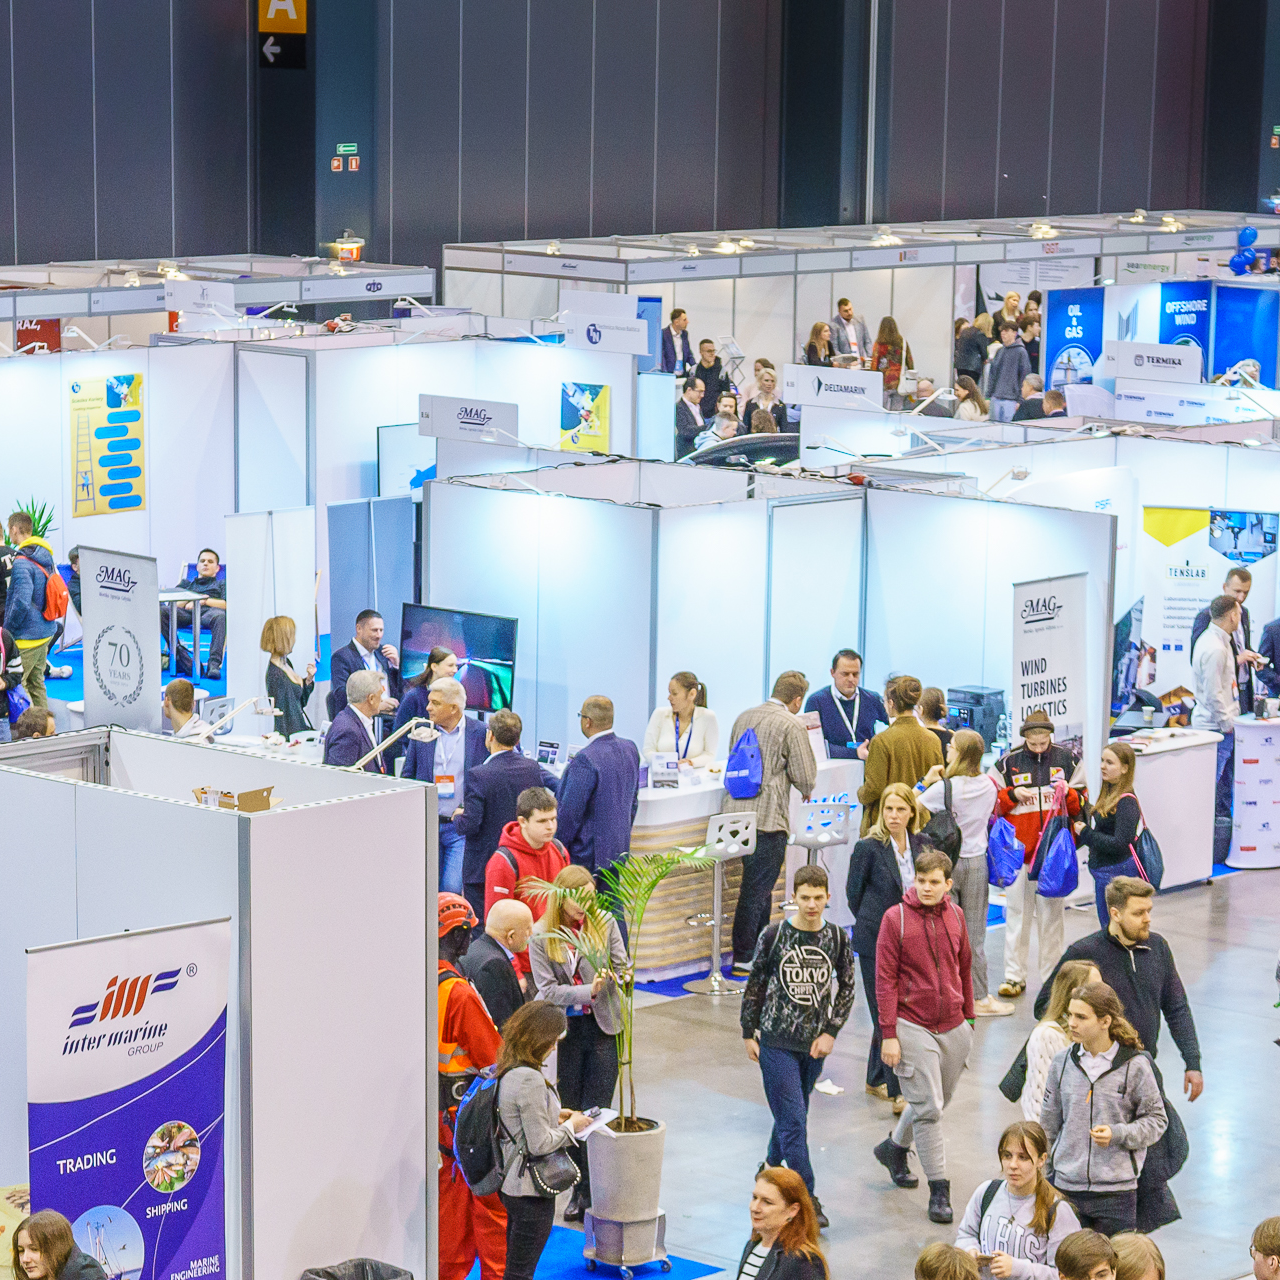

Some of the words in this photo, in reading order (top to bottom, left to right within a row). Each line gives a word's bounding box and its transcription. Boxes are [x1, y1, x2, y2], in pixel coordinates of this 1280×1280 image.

[267, 0, 297, 19] A
[1067, 305, 1082, 316] OIL
[1165, 300, 1208, 313] OFFSHORE
[1174, 313, 1197, 326] WIND
[1065, 326, 1083, 338] GAS
[1146, 356, 1182, 366] TERMIKA
[824, 383, 866, 395] DELTAMARIN
[96, 565, 134, 590] MAG
[1169, 568, 1206, 578] TENSLAB
[1021, 596, 1059, 619] MAG
[108, 641, 131, 668] 70
[109, 669, 131, 681] YEARS
[1021, 658, 1047, 677] WIND
[1021, 676, 1067, 700] TURBINES
[1021, 699, 1067, 722] LOGISTICS
[783, 967, 828, 983] TOKYO
[62, 1032, 106, 1056] inter
[108, 1021, 168, 1050] marine
[127, 1042, 164, 1057] GROUP
[56, 1148, 117, 1176] TRADING
[145, 1198, 188, 1219] SHIPPING
[189, 1254, 219, 1270] MARINE
